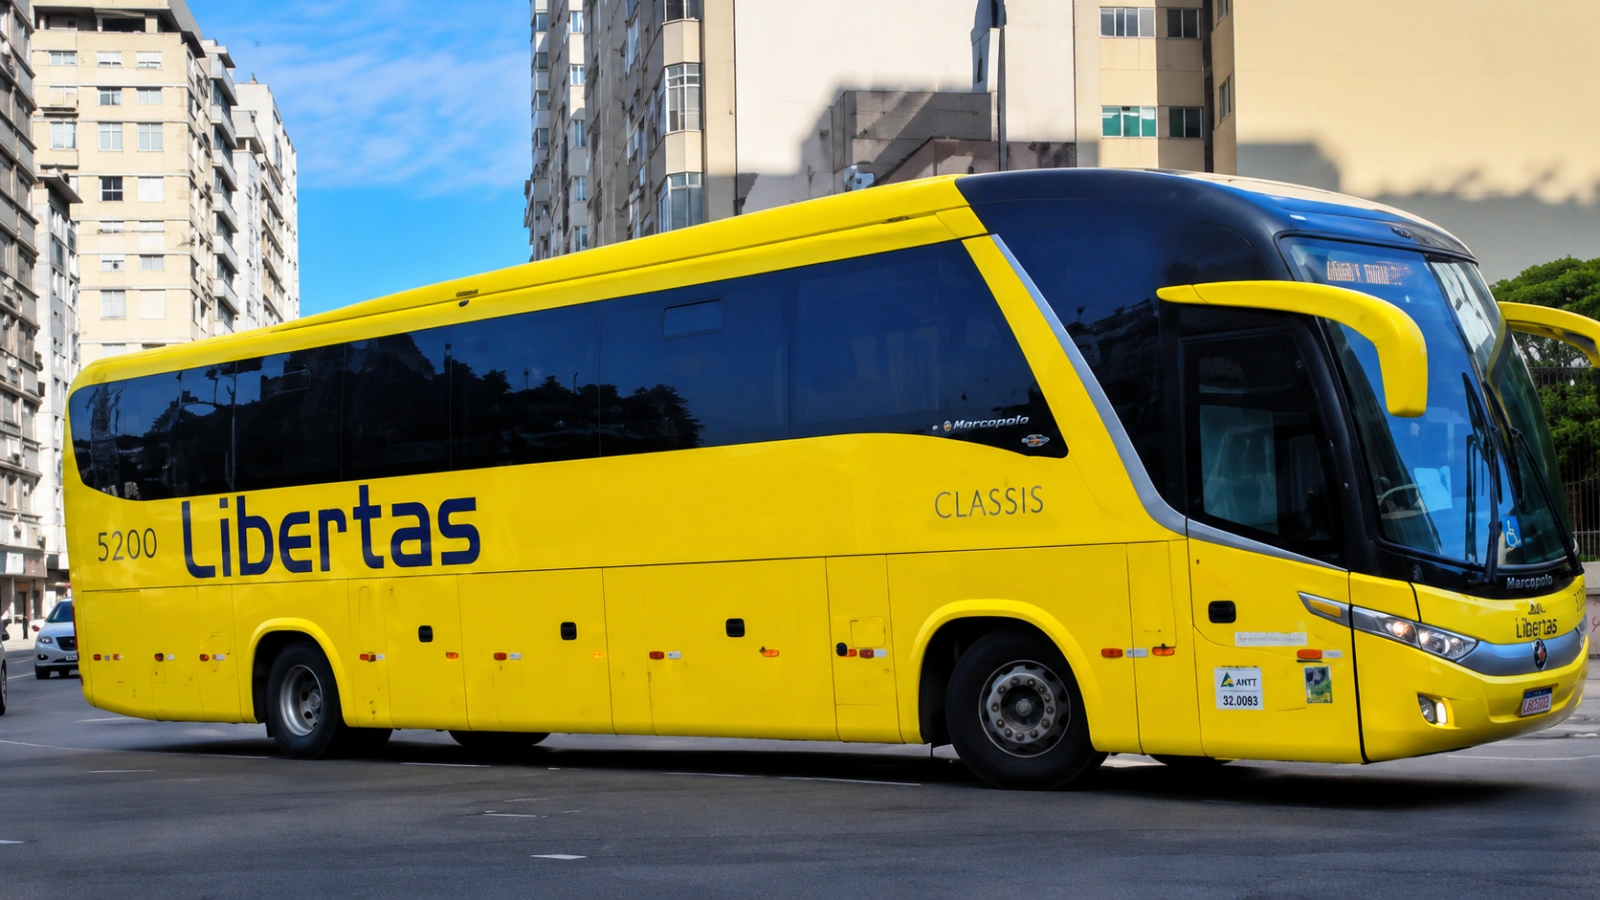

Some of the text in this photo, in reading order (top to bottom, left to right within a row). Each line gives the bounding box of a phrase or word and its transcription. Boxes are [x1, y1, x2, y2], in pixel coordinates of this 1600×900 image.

[953, 415, 1029, 429] Marcopolo
[935, 485, 1043, 518] CLASSIS
[181, 484, 481, 579] Libertas
[97, 527, 157, 562] 5200
[1507, 574, 1553, 589] Marcopolo
[1515, 617, 1557, 638] Libertas
[1236, 678, 1257, 687] ANTT
